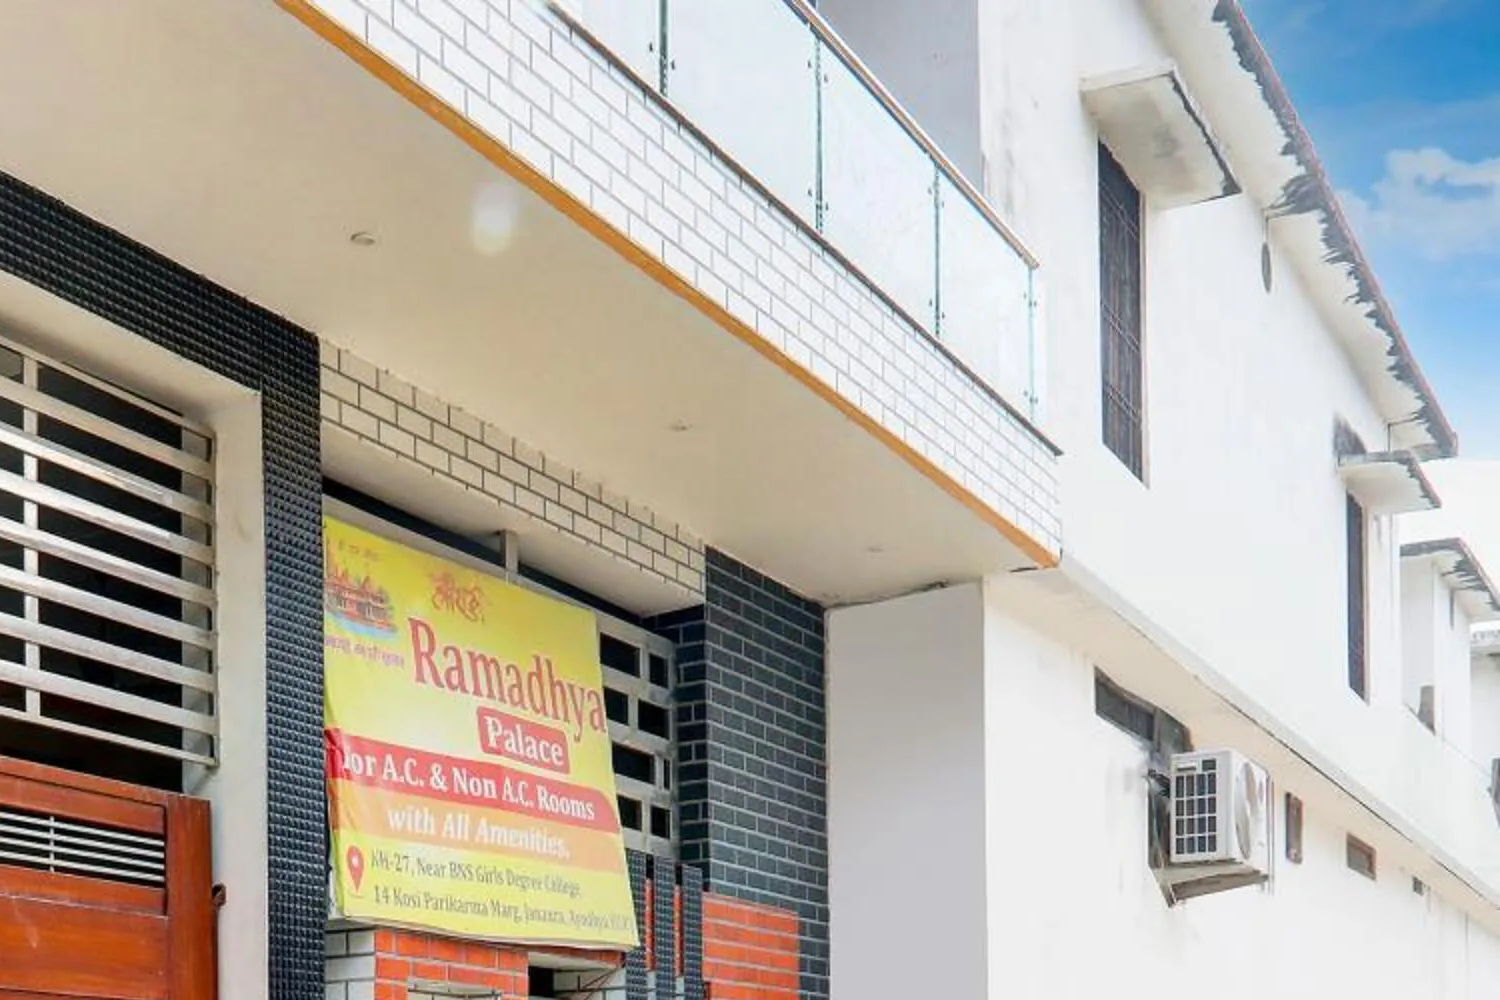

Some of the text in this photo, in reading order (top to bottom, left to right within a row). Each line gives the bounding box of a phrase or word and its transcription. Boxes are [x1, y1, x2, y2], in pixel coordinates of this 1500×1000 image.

[408, 616, 607, 744] Ramadhya
[483, 715, 565, 766] Palace
[382, 752, 425, 788] A.C.
[429, 762, 449, 793] &
[451, 766, 498, 800] Non
[501, 775, 535, 809] A.C.
[536, 784, 596, 821] Rooms
[387, 804, 436, 836] with
[441, 811, 470, 841] All
[417, 857, 447, 879] Near
[475, 864, 505, 886] Girls
[374, 884, 390, 906] 14
[393, 886, 421, 909] Kosi
